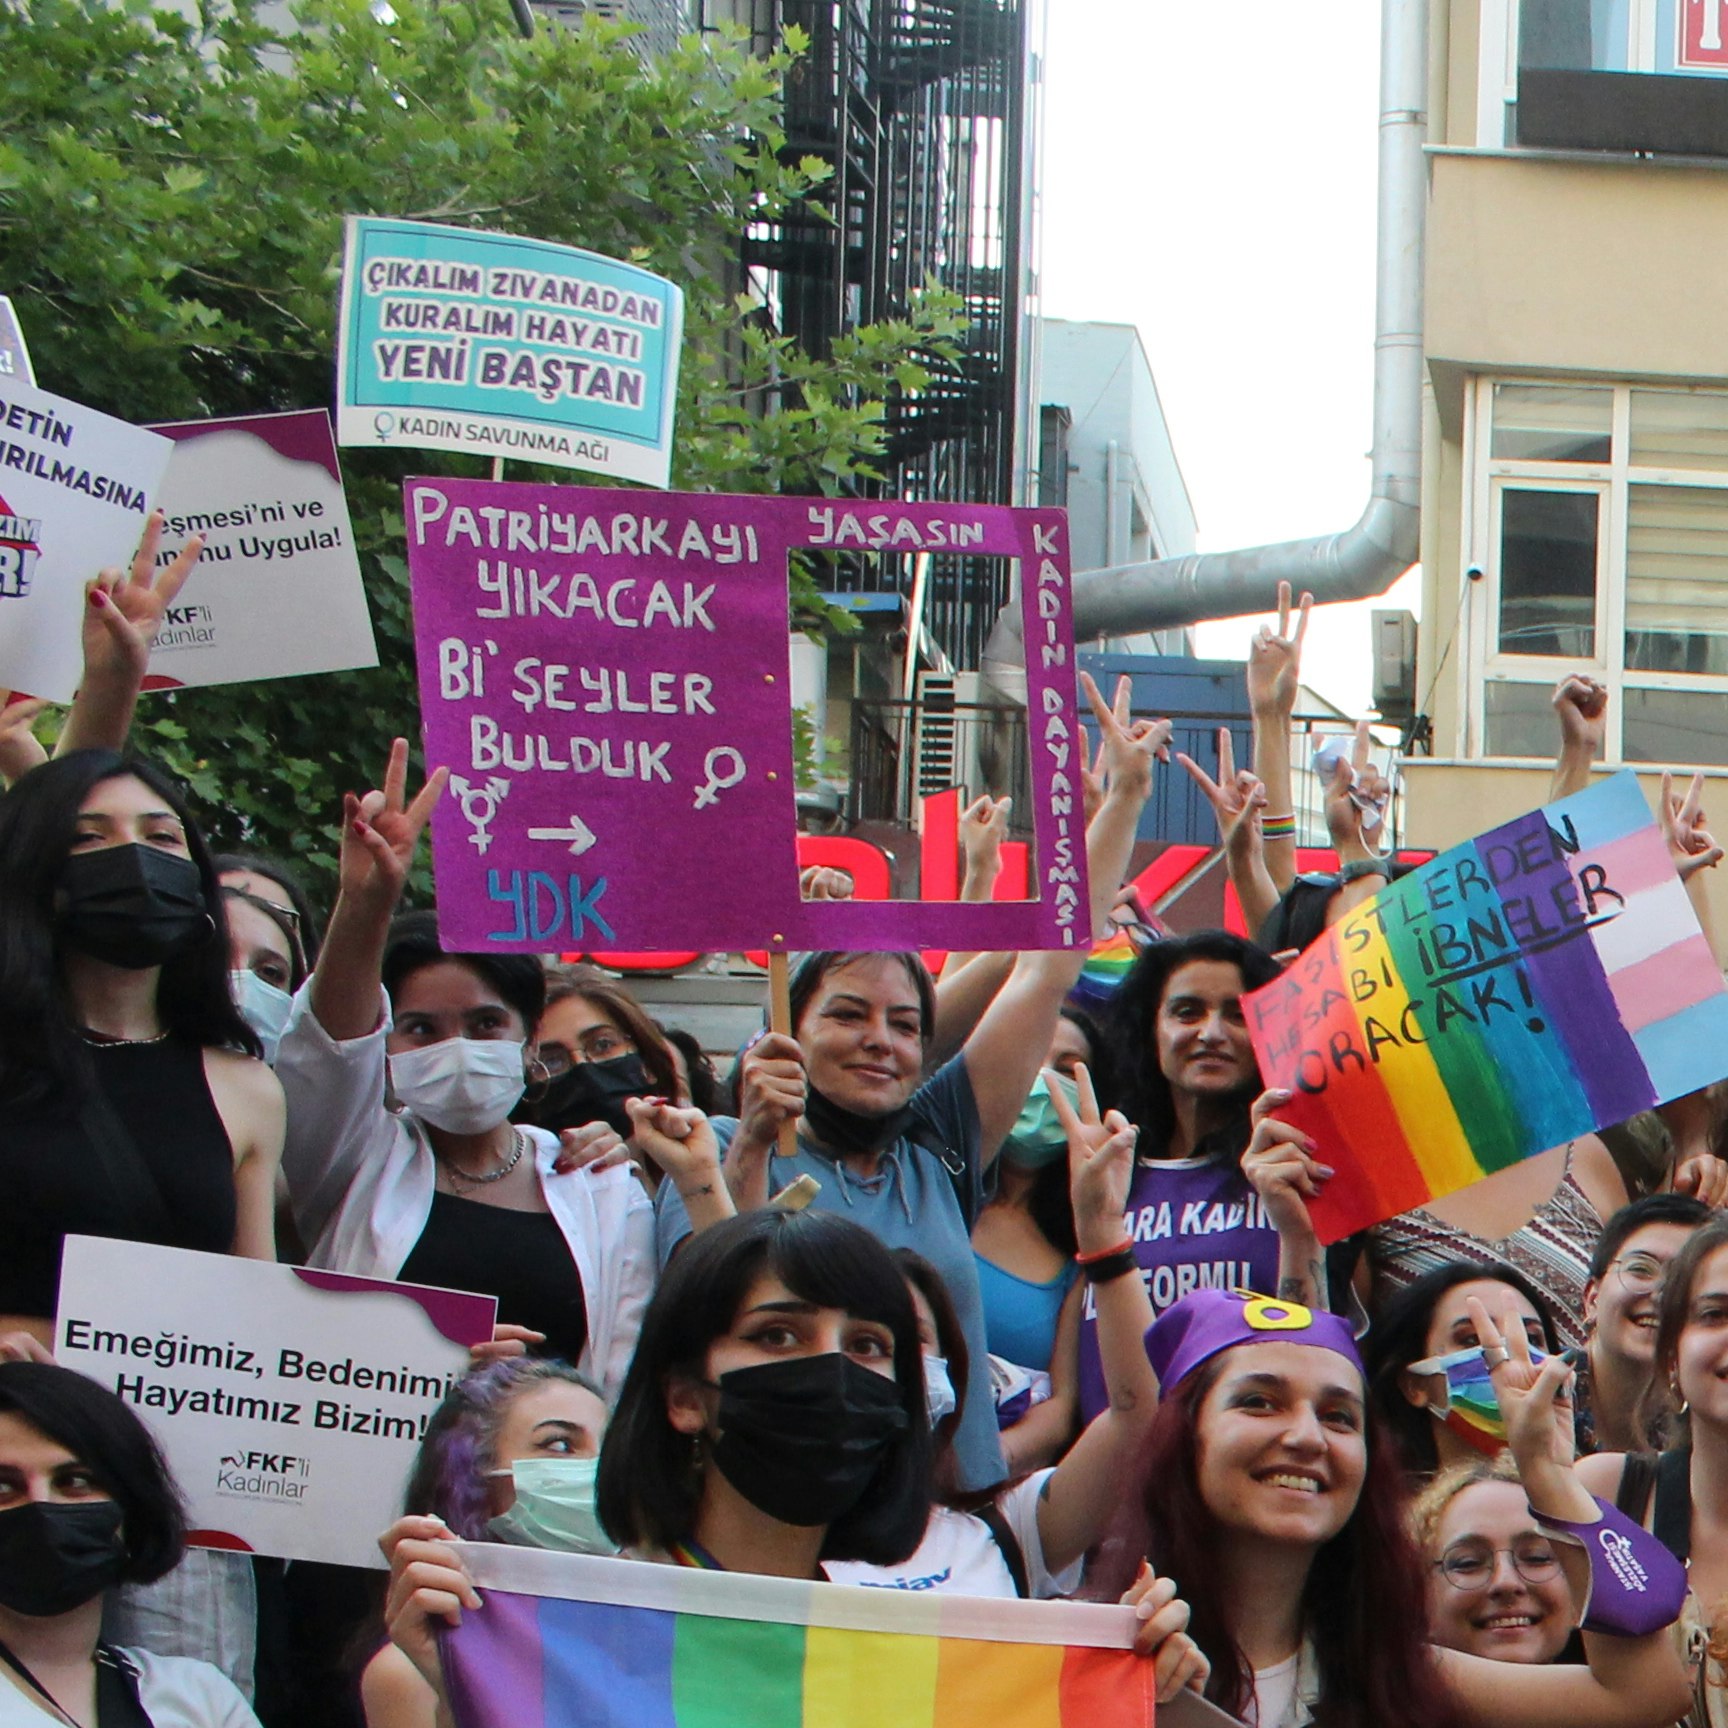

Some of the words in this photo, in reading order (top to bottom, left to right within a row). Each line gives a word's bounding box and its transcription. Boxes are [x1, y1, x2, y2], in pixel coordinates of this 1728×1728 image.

[367, 260, 480, 295] ÇIKALIM
[491, 271, 660, 327] ZIVANADAN
[384, 302, 514, 338] KURALIM
[525, 314, 641, 360] HAYATI
[377, 338, 468, 382] YENİ
[481, 351, 642, 407] BAŞTAN
[400, 416, 460, 440] KADIN
[466, 423, 571, 456] SAVUNMA
[575, 439, 610, 463] AĞI
[161, 502, 286, 537] eşmesi'ni
[292, 500, 325, 520] ve
[239, 526, 343, 562] Uygula!
[411, 485, 760, 566] PATRİYARKAYI
[807, 503, 984, 551] YAŞASIN
[165, 605, 213, 627] KF'li
[475, 557, 718, 633] YIKACAK
[1029, 521, 1068, 670] KADIN
[151, 624, 217, 649] adınlar
[512, 656, 716, 716] ŞEYLER
[470, 713, 672, 784] BULDUK
[1040, 685, 1081, 948] DAYANIŞMASI
[485, 868, 616, 942] YDK
[1416, 863, 1627, 978] İBNELER
[63, 1318, 265, 1382] Emeğimiz,
[114, 1372, 301, 1426] Hayatımız
[313, 1399, 428, 1444] Bizim!
[216, 1469, 310, 1501] Kadınlar
[245, 1450, 311, 1478] FKF'li
